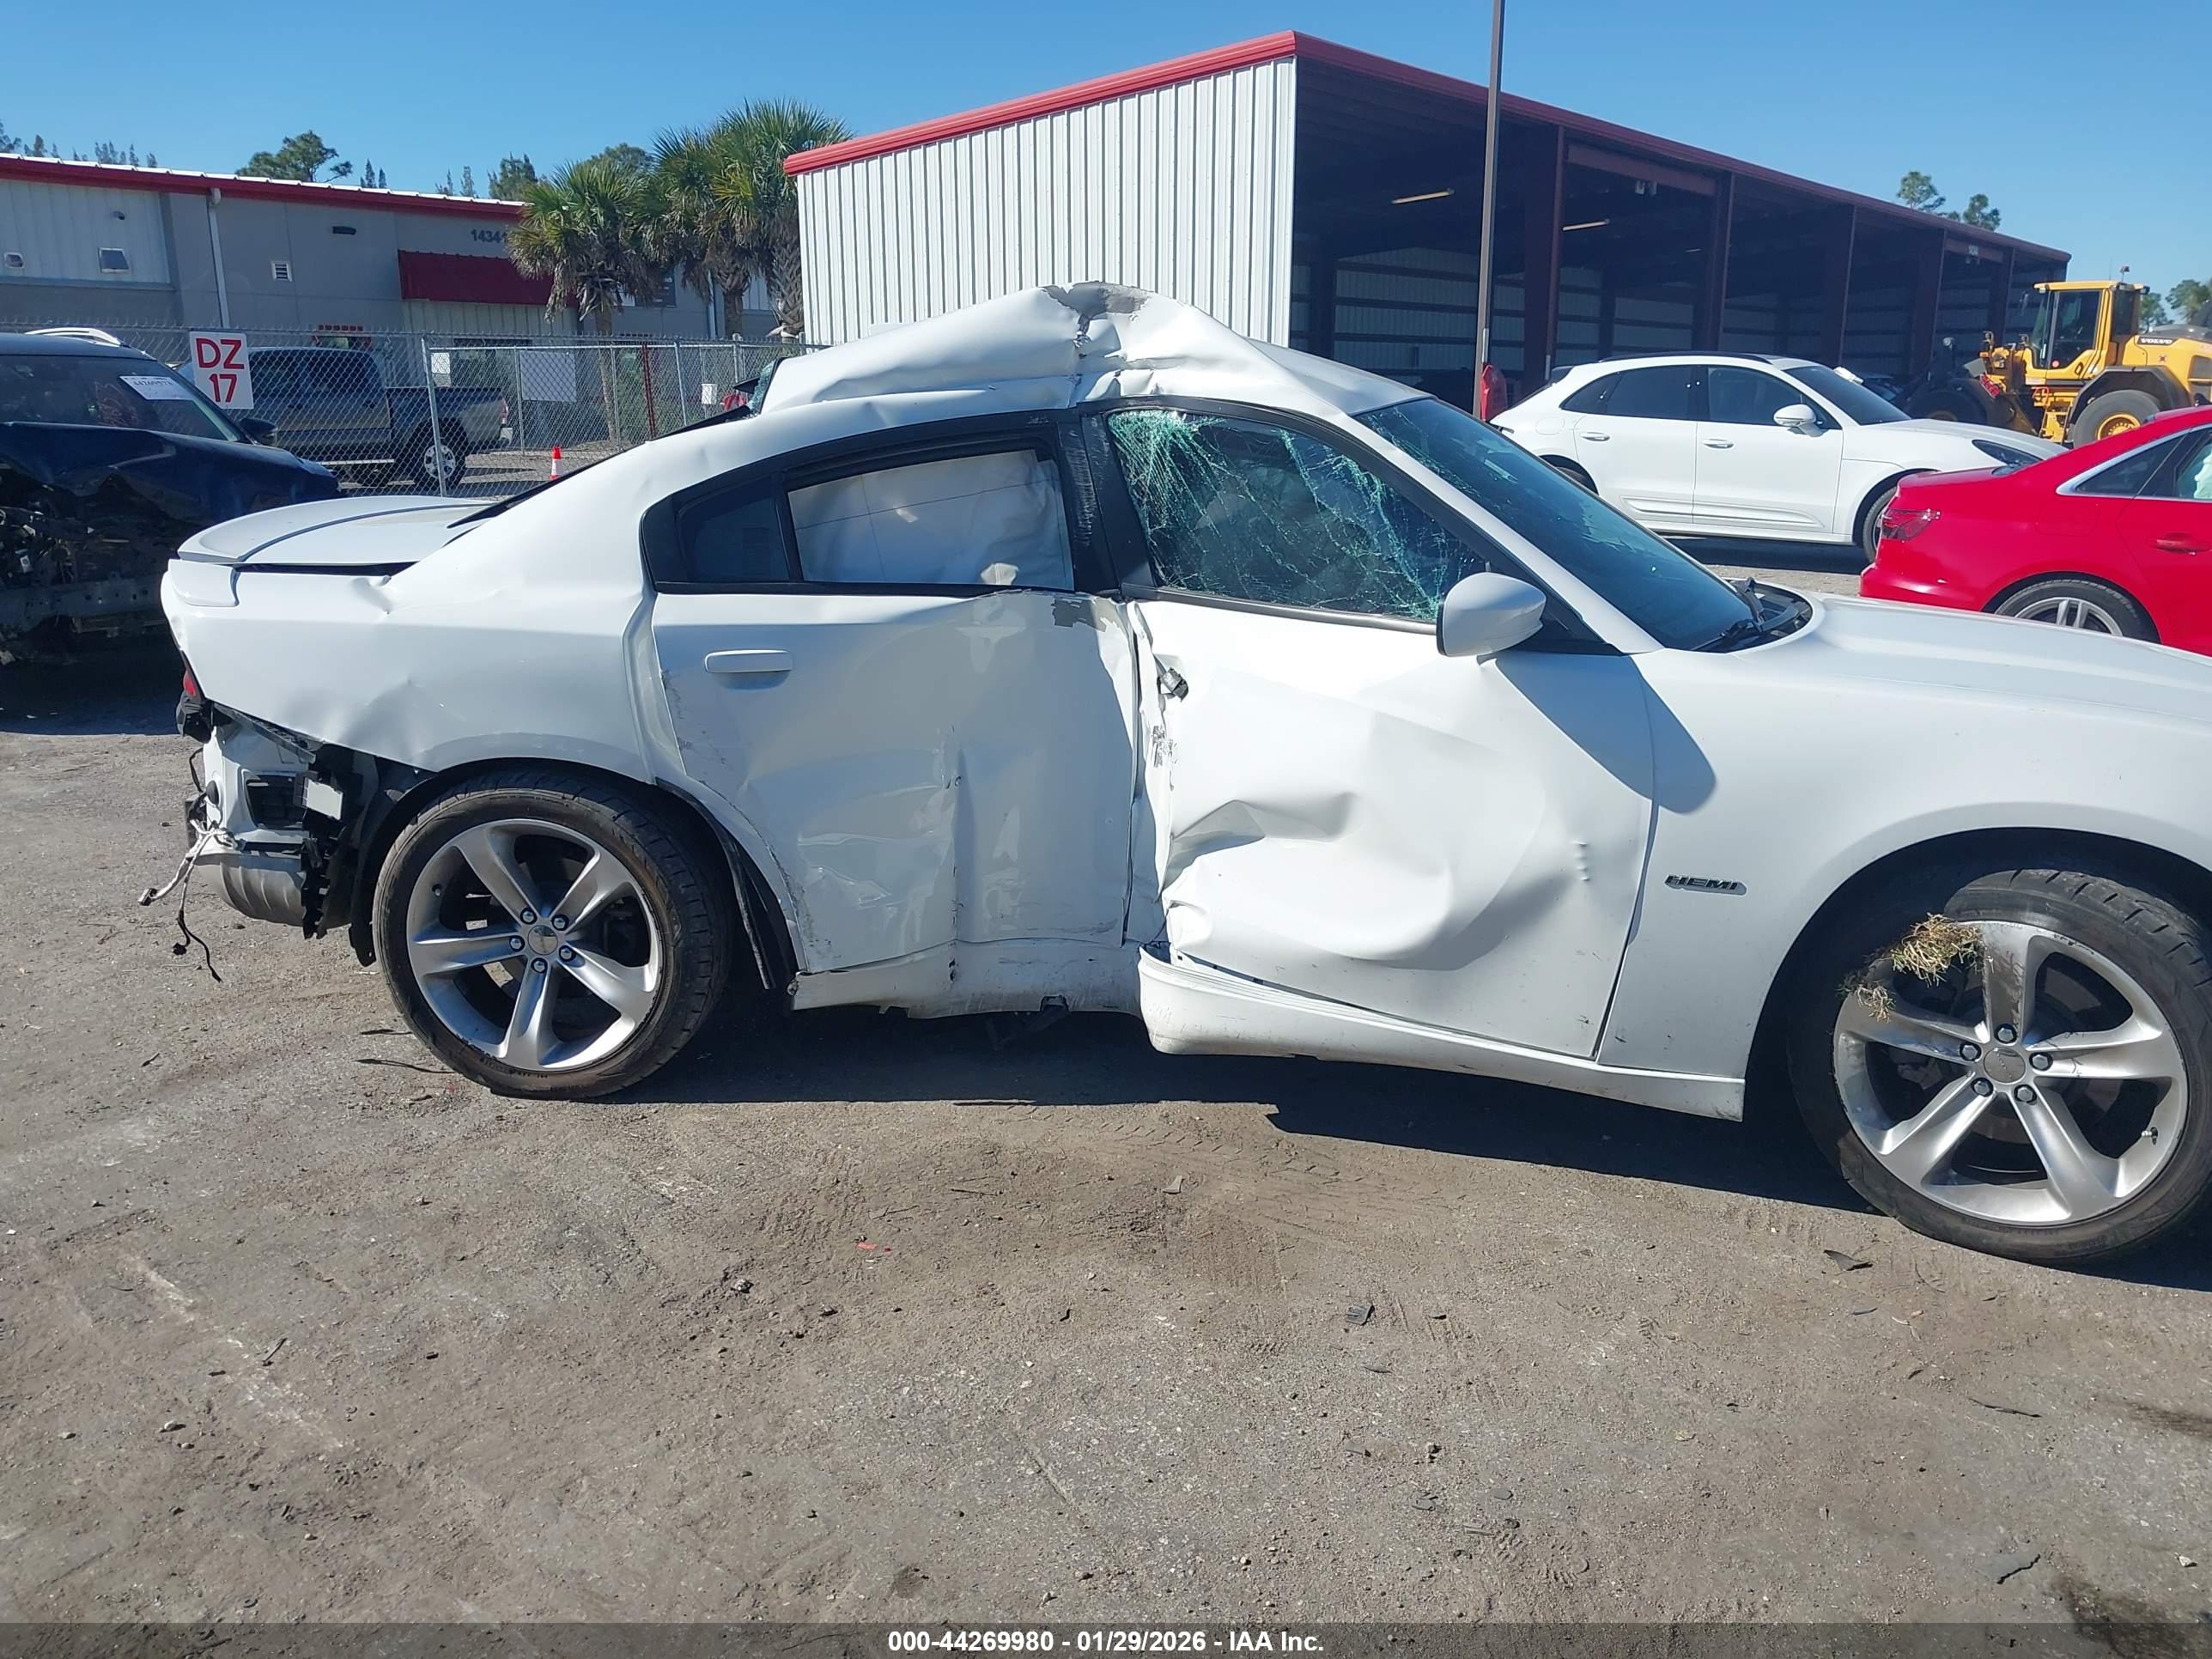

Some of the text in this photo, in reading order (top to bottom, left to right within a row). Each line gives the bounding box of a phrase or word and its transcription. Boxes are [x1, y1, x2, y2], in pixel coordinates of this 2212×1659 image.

[196, 337, 245, 369] DZ
[209, 374, 238, 403] 17
[1664, 875, 1738, 890] HEMI
